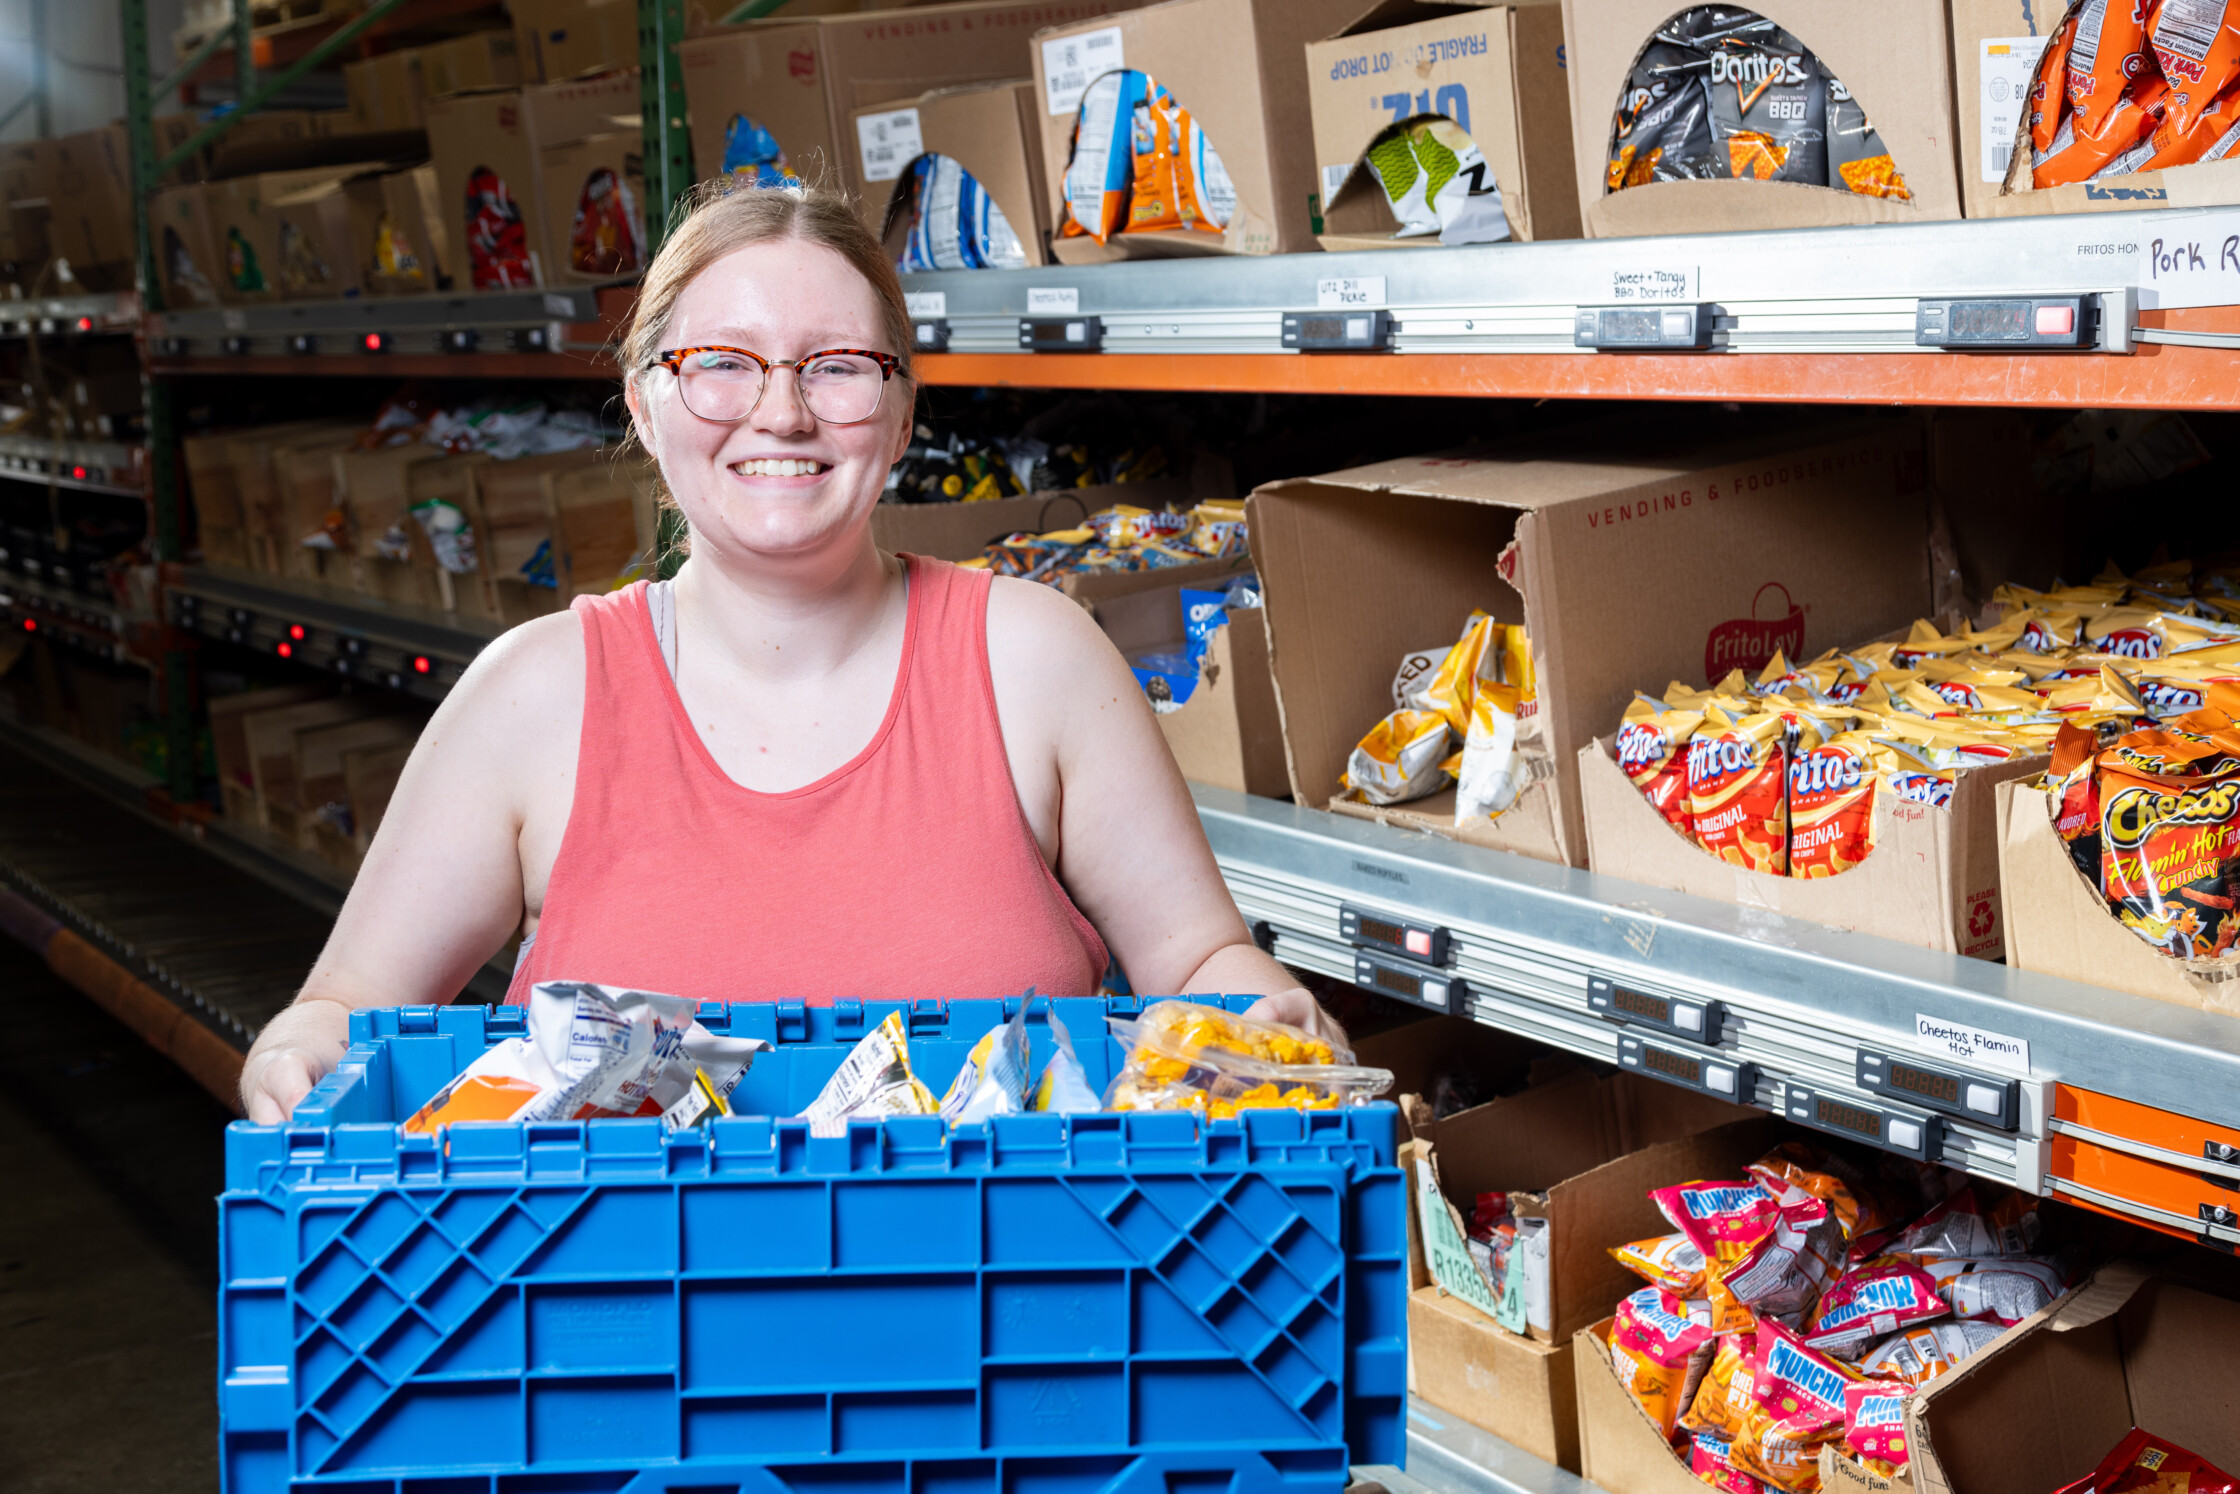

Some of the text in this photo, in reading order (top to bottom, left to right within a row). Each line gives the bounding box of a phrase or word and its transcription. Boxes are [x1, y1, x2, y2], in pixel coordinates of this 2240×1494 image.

[1428, 34, 1487, 63] FRAGILE
[2153, 36, 2205, 60] Nutrition Facts
[1330, 56, 1368, 81] DROP
[1711, 51, 1810, 84] Doritos
[2171, 58, 2207, 83] Pork
[1769, 102, 1807, 119] BBQ
[2078, 244, 2114, 255] FRITOS
[2152, 238, 2206, 279] Pork
[1614, 272, 1644, 285] Sweet
[1654, 271, 1686, 288] Tangy
[1640, 287, 1685, 298] Doritos
[1588, 446, 1884, 529] VENDING & FOODSERVICE
[1789, 751, 1862, 795] ritos
[1792, 796, 1826, 806] BRAND
[1702, 804, 1747, 832] ORIGINAL
[1906, 808, 1924, 822] fun!
[1792, 821, 1844, 850] RIGINAL
[2192, 825, 2234, 858] Hot
[2155, 857, 2220, 896] Crunchy
[1967, 888, 1996, 904] PLEASE
[1964, 936, 2000, 956] RECYCLE
[1920, 1020, 2019, 1054] Cheetos Flamin
[1949, 1042, 1974, 1057] Hot
[1786, 1384, 1812, 1402] SNACK
[1814, 1400, 1830, 1412] MIX
[1762, 1447, 1798, 1466] FIX
[1840, 1464, 1866, 1485] Good
